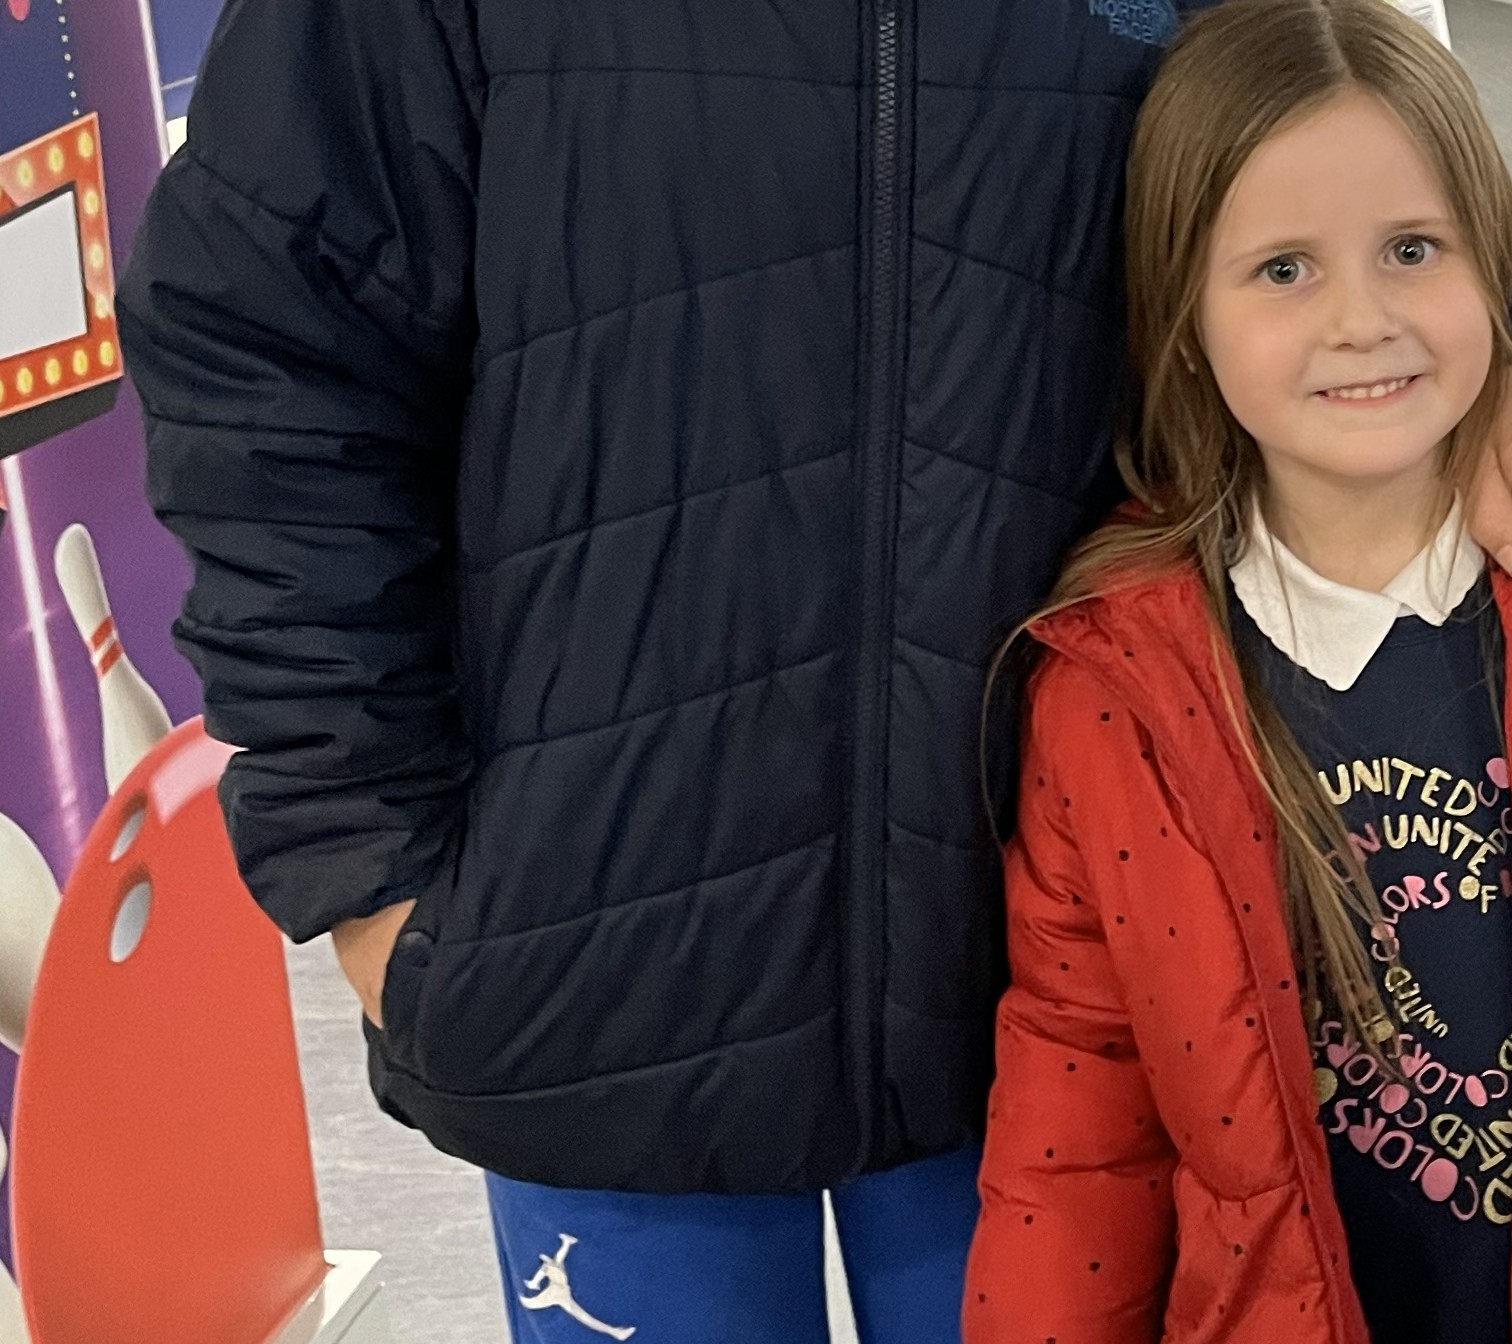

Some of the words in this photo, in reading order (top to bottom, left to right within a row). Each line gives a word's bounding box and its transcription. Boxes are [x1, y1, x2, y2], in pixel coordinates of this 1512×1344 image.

[1317, 757, 1478, 817] UNITED
[1458, 875, 1499, 914] OF
[1328, 1098, 1480, 1222] COLORS
